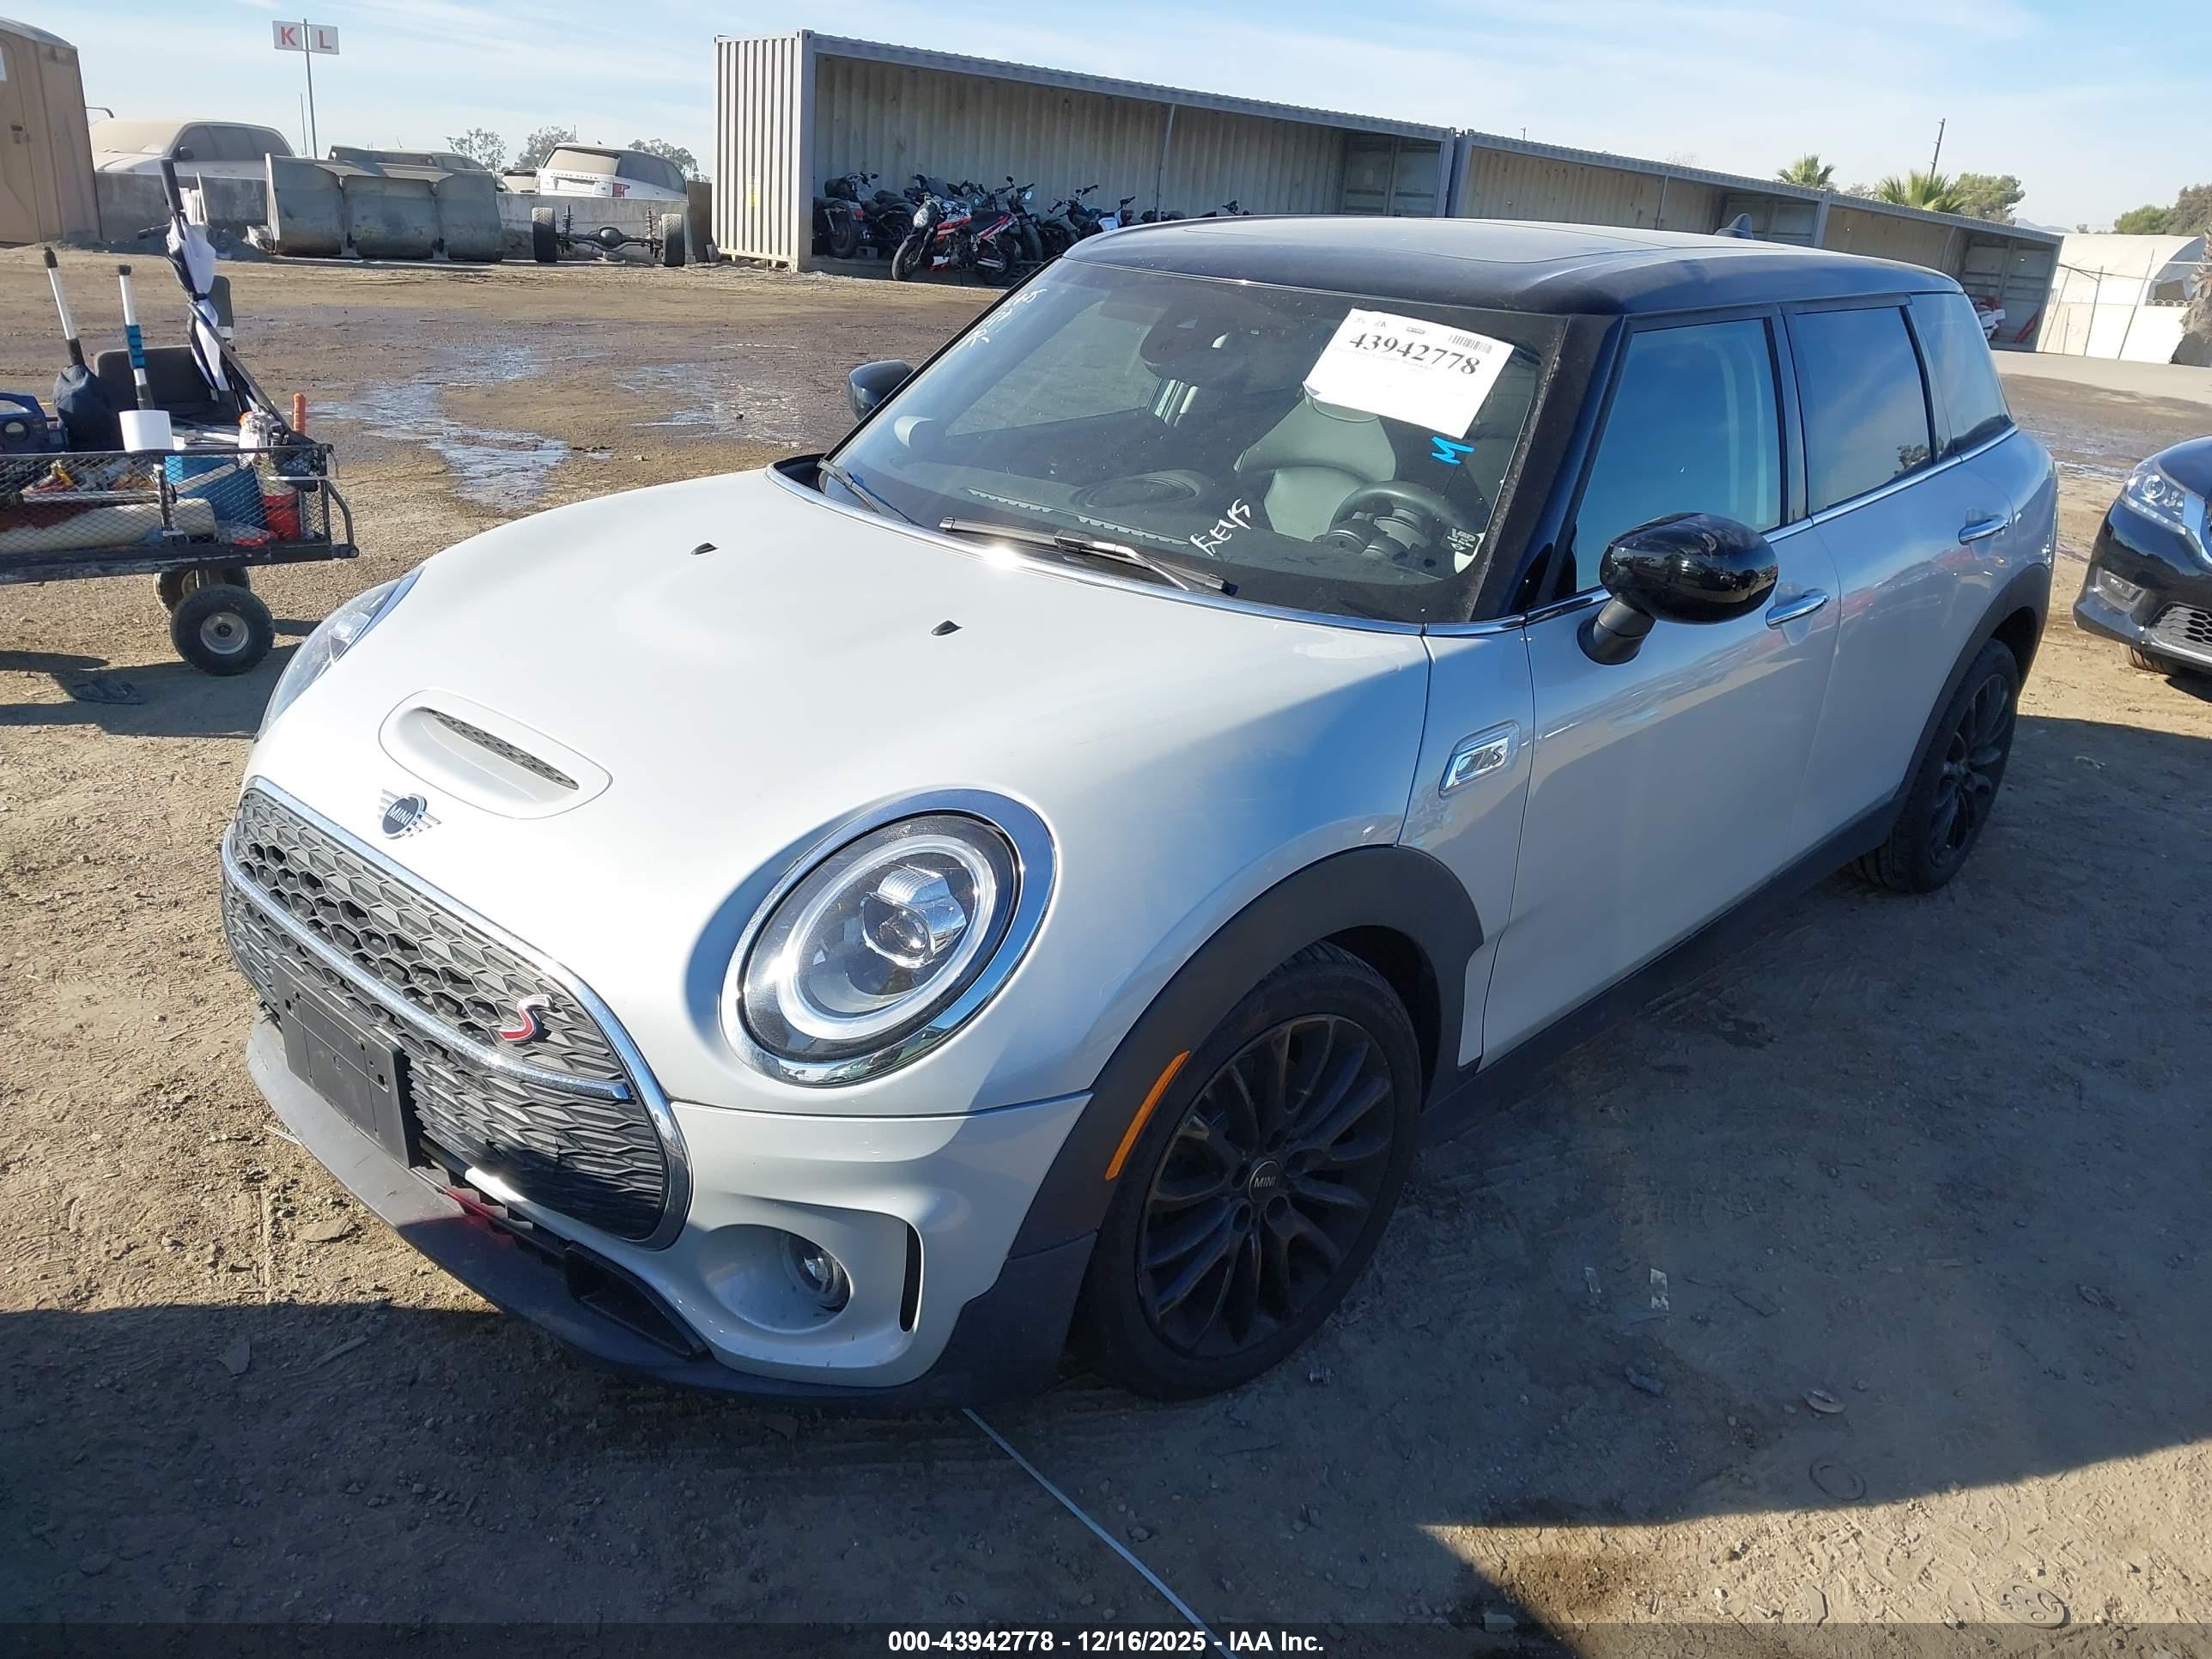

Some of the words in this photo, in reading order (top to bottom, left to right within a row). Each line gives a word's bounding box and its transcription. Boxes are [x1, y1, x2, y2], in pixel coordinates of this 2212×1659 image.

[281, 27, 295, 46] K
[319, 30, 331, 49] L
[1349, 332, 1480, 374] 43942778
[387, 805, 414, 826] MINI
[498, 994, 556, 1043] S
[1254, 1176, 1277, 1188] MINI
